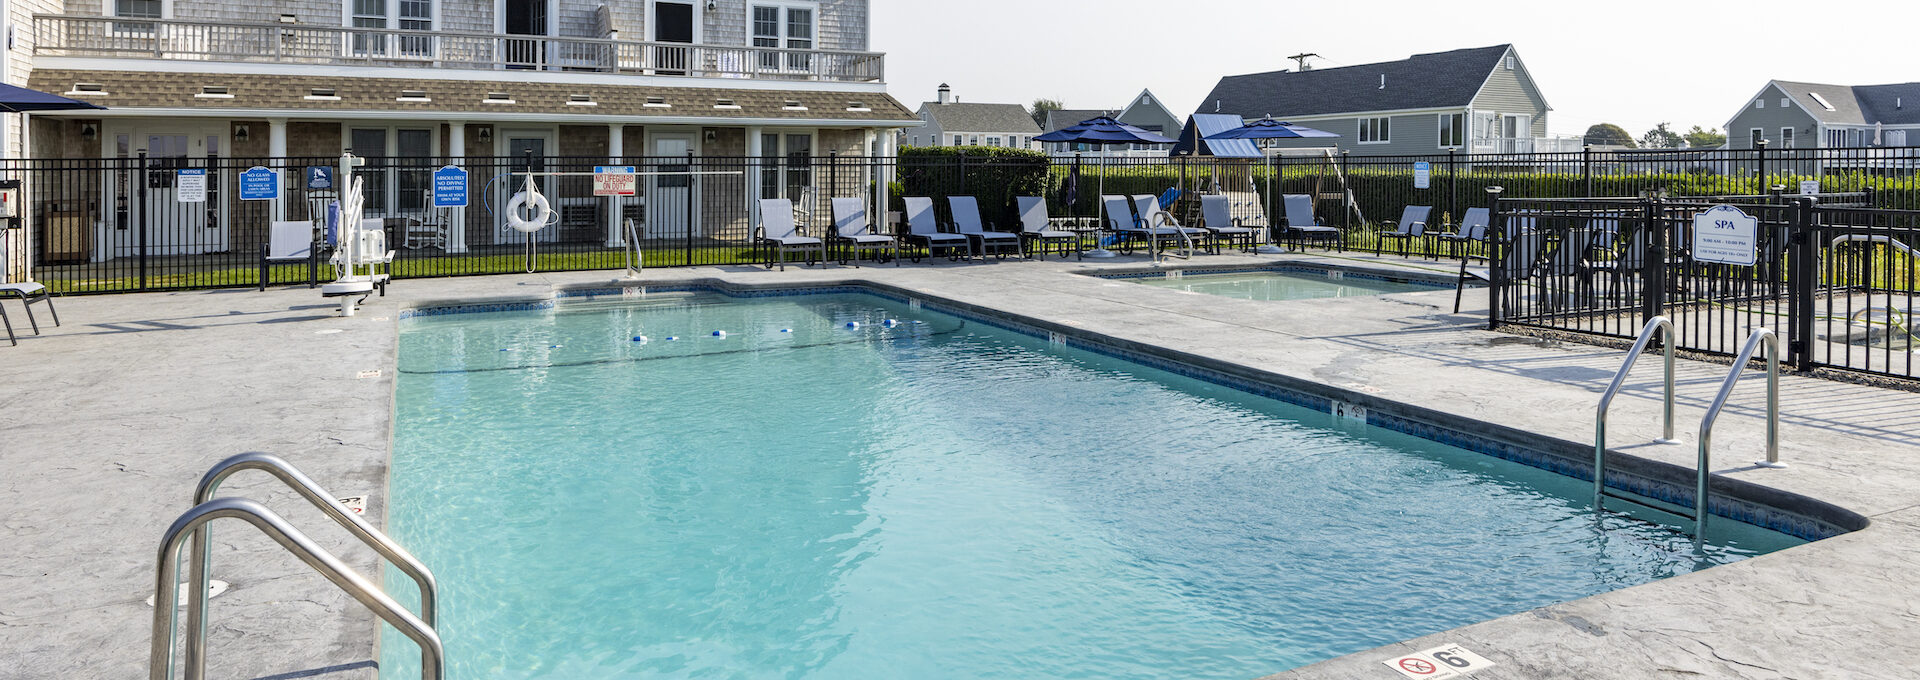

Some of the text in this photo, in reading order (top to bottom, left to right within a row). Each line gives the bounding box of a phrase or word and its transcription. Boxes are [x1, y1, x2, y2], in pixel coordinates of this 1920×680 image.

[595, 174, 634, 182] NO LIFEGUARD
[1714, 220, 1735, 230] SPA
[1337, 402, 1344, 416] 6
[1448, 646, 1465, 654] FT
[1432, 652, 1470, 668] 6
